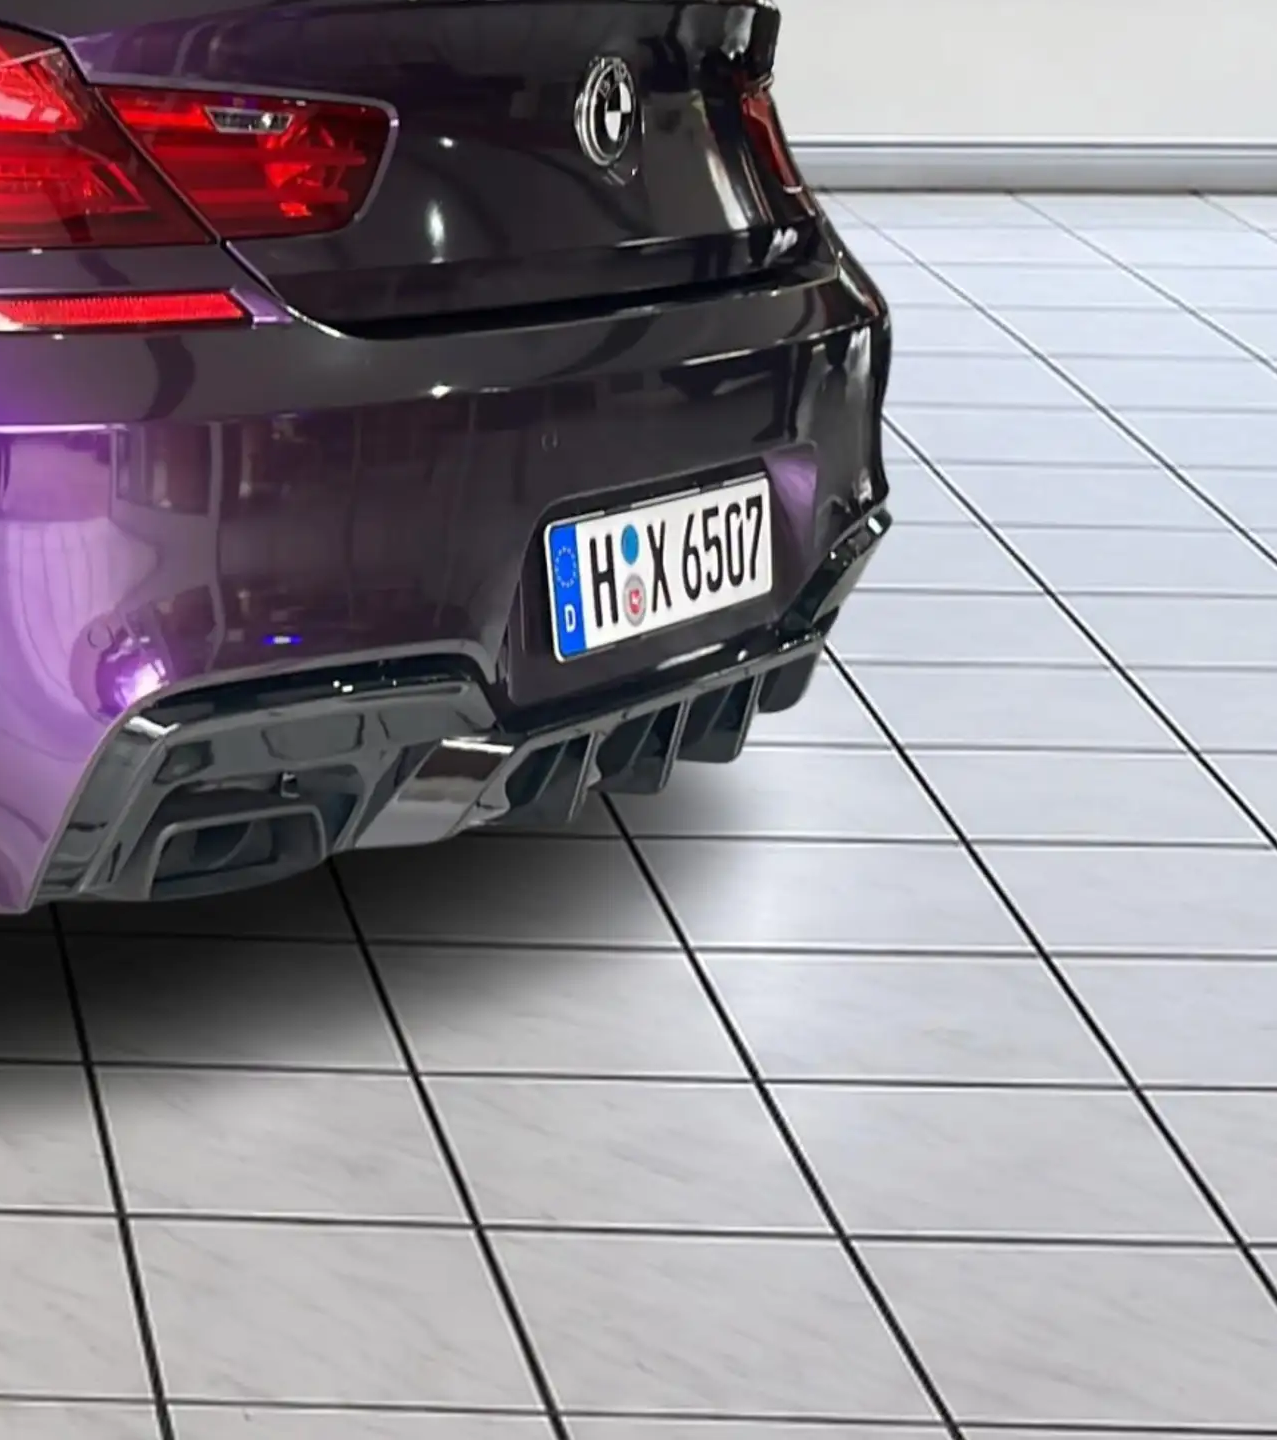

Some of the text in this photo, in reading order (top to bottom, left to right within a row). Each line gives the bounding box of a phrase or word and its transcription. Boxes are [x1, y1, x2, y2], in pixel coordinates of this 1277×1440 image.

[589, 494, 763, 628] H X 6507
[564, 604, 577, 633] D
